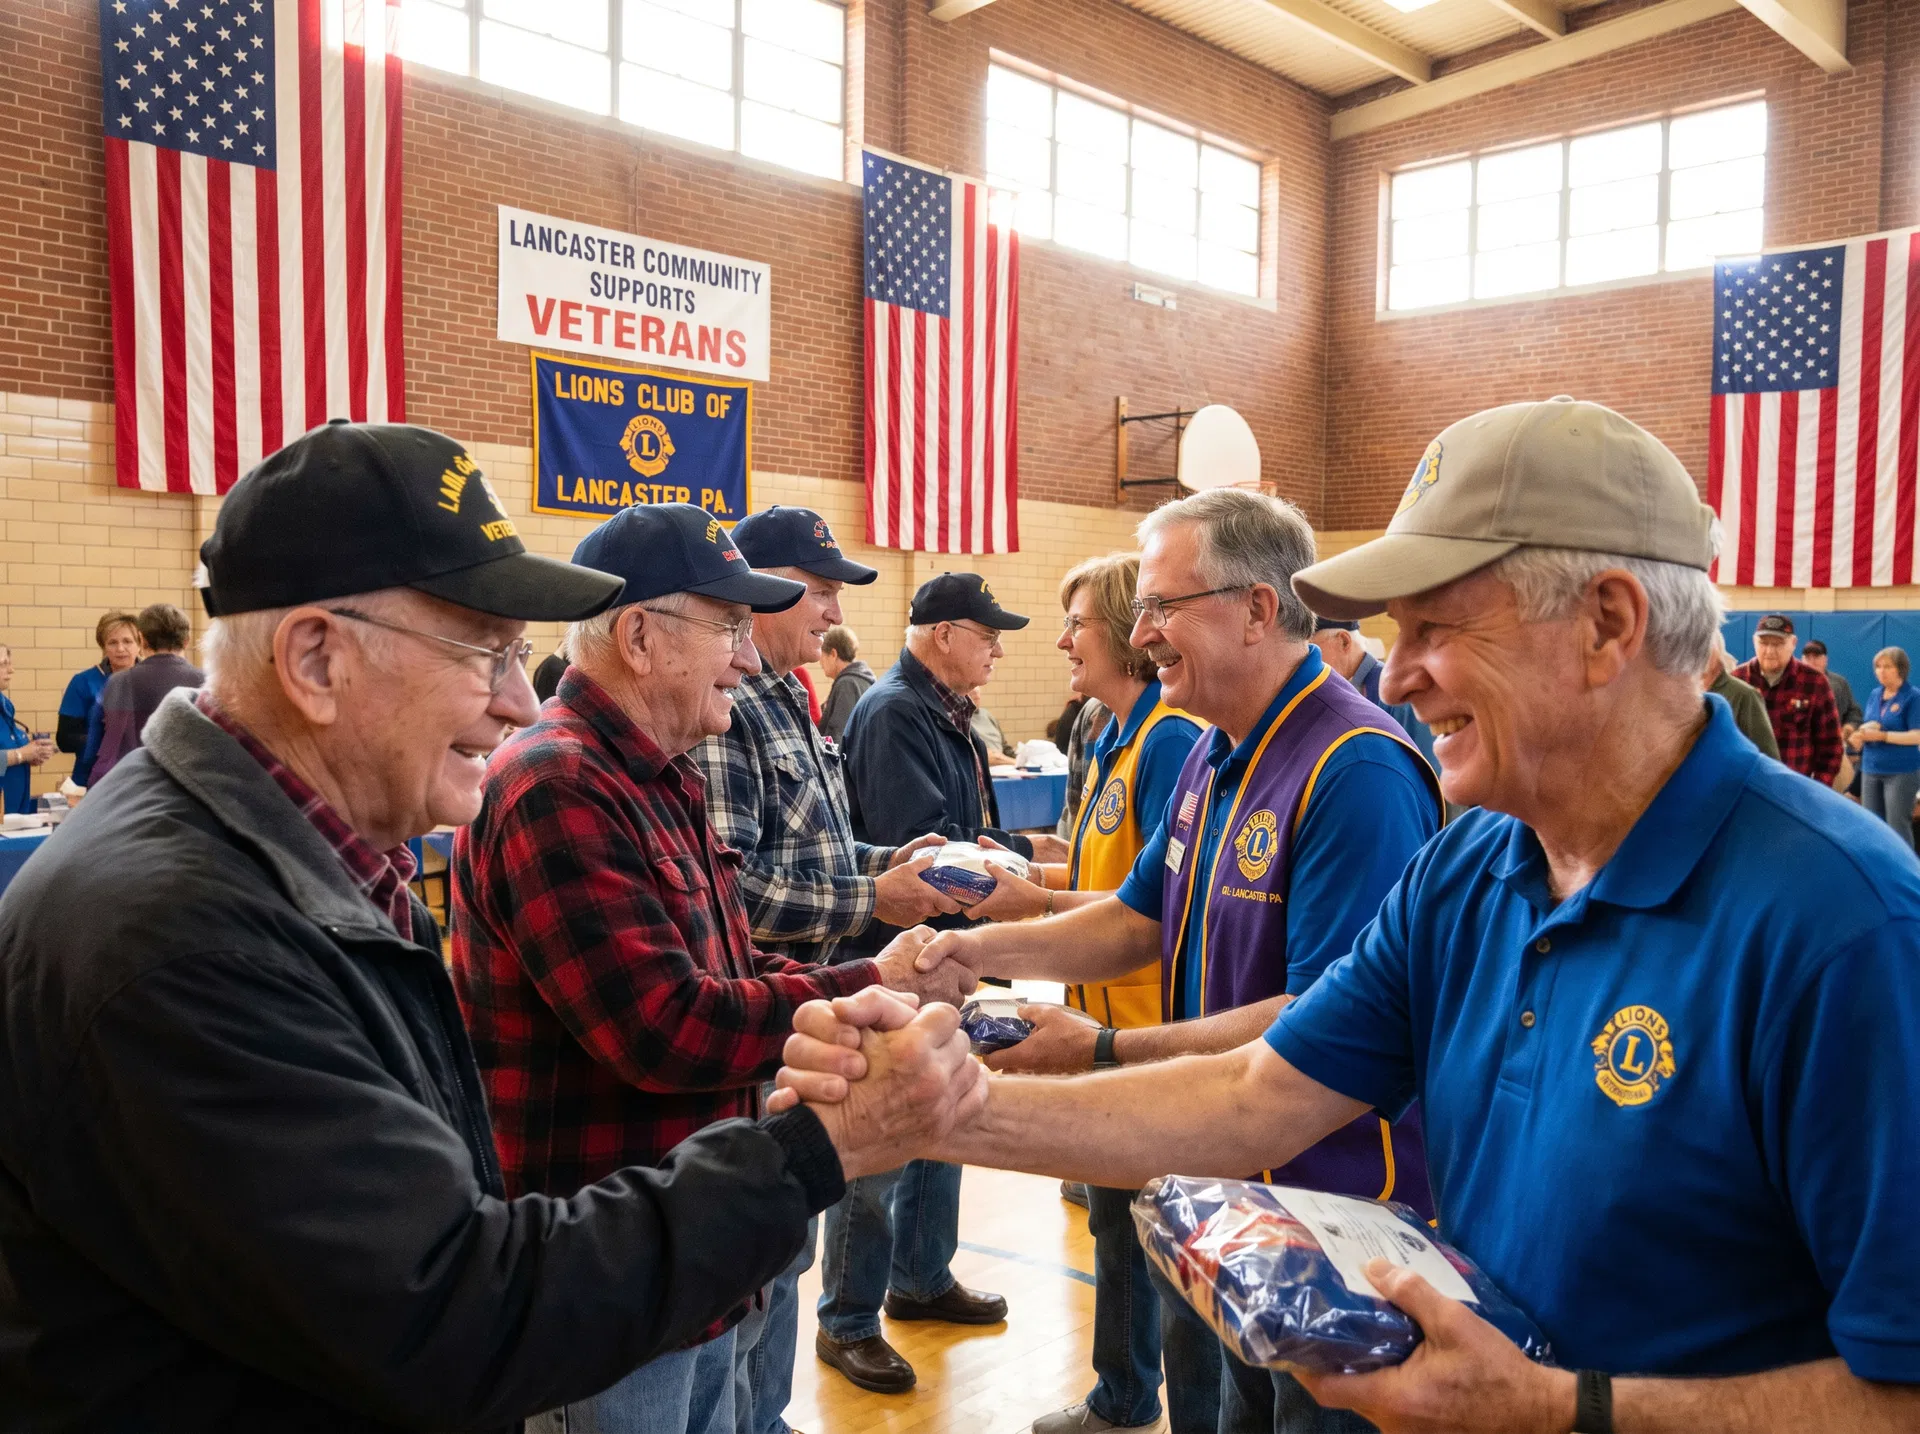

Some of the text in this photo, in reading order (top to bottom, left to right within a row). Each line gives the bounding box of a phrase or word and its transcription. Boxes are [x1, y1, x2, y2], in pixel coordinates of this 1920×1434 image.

[510, 220, 762, 294] LANCASTER COMMUNITY
[590, 271, 696, 314] SUPPORTS
[526, 294, 747, 368] VETERANS
[555, 371, 732, 419] LIONS CLUB OF
[641, 433, 656, 457] L
[557, 475, 733, 514] LANCASTER PA.
[1251, 831, 1264, 857] L
[1232, 888, 1267, 902] LANCASTER
[1619, 1008, 1666, 1036] LIONS
[1620, 1035, 1644, 1075] L
